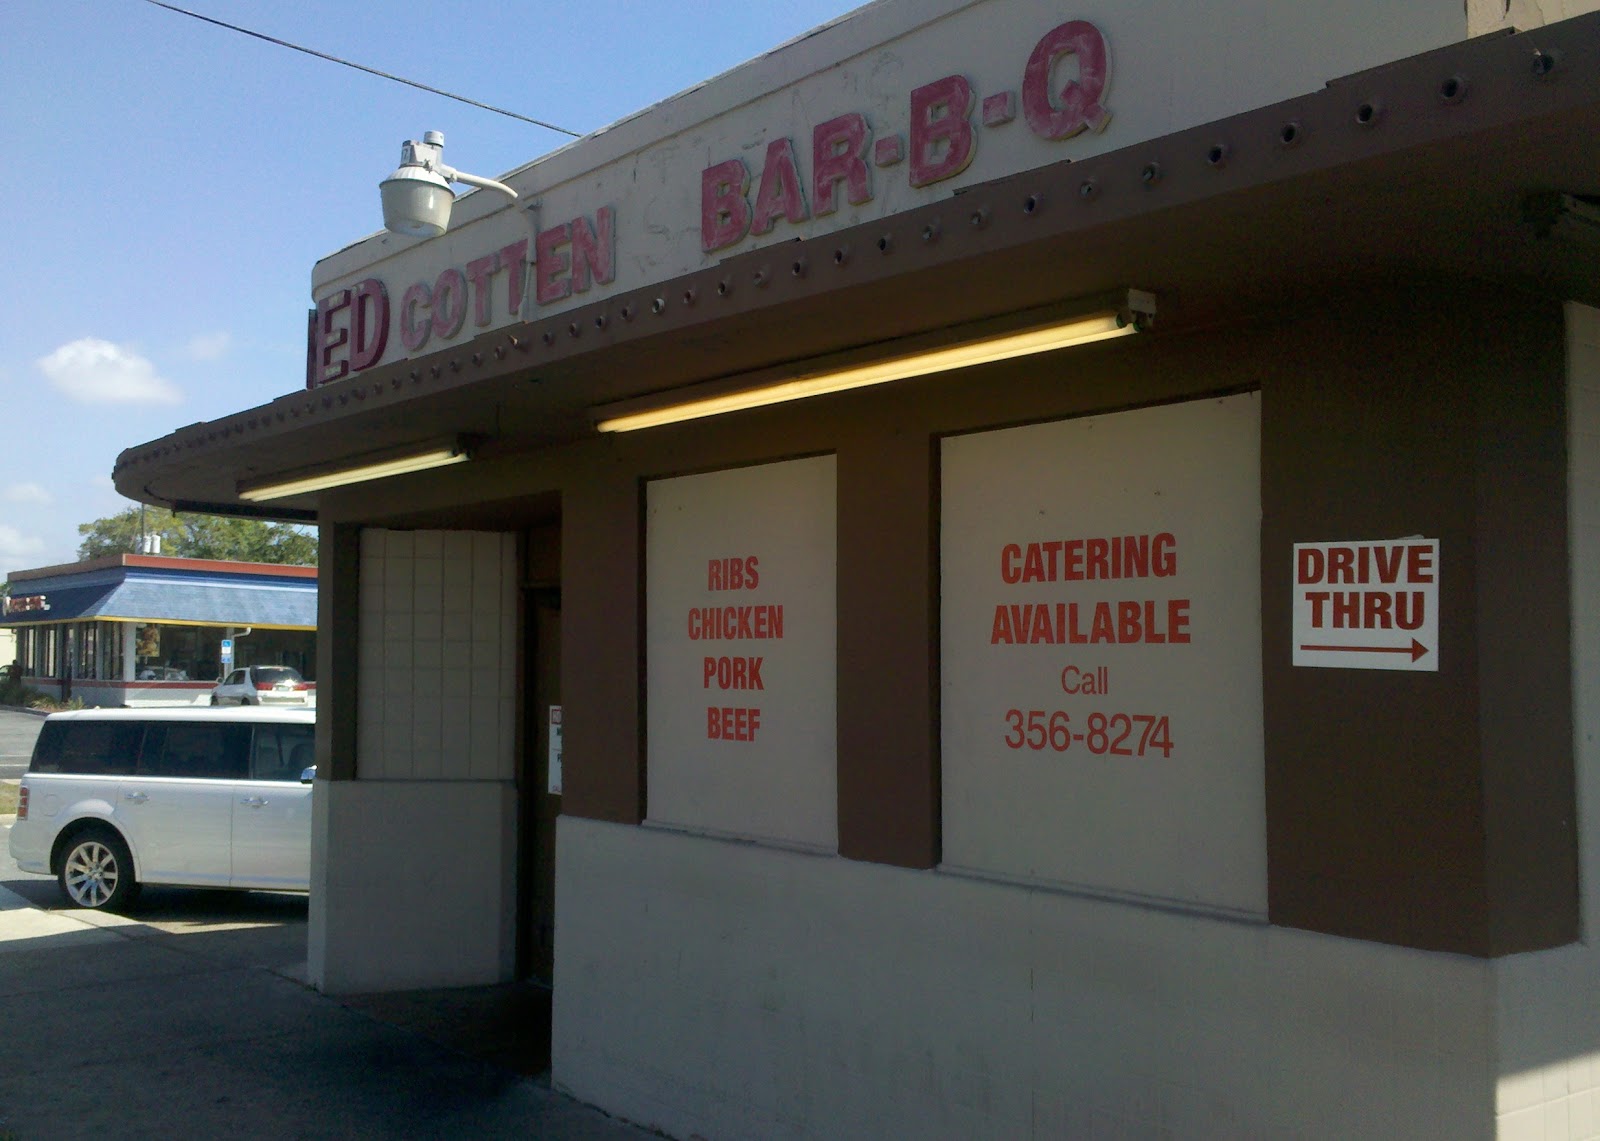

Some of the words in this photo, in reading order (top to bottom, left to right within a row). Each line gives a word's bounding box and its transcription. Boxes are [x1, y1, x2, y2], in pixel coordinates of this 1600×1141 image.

[401, 205, 616, 352] COTTEN
[702, 20, 1113, 254] BAR-B-Q
[708, 556, 760, 592] RIBS
[1001, 532, 1177, 585] CATERING
[1298, 545, 1434, 585] DRIVE
[688, 604, 784, 641] CHICKEN
[991, 599, 1191, 645] AVAILABLE
[1305, 591, 1425, 631] THRU
[704, 656, 765, 691] PORK
[1061, 665, 1109, 695] Call
[707, 706, 761, 742] BEEF
[1004, 709, 1175, 759] 356-8274
